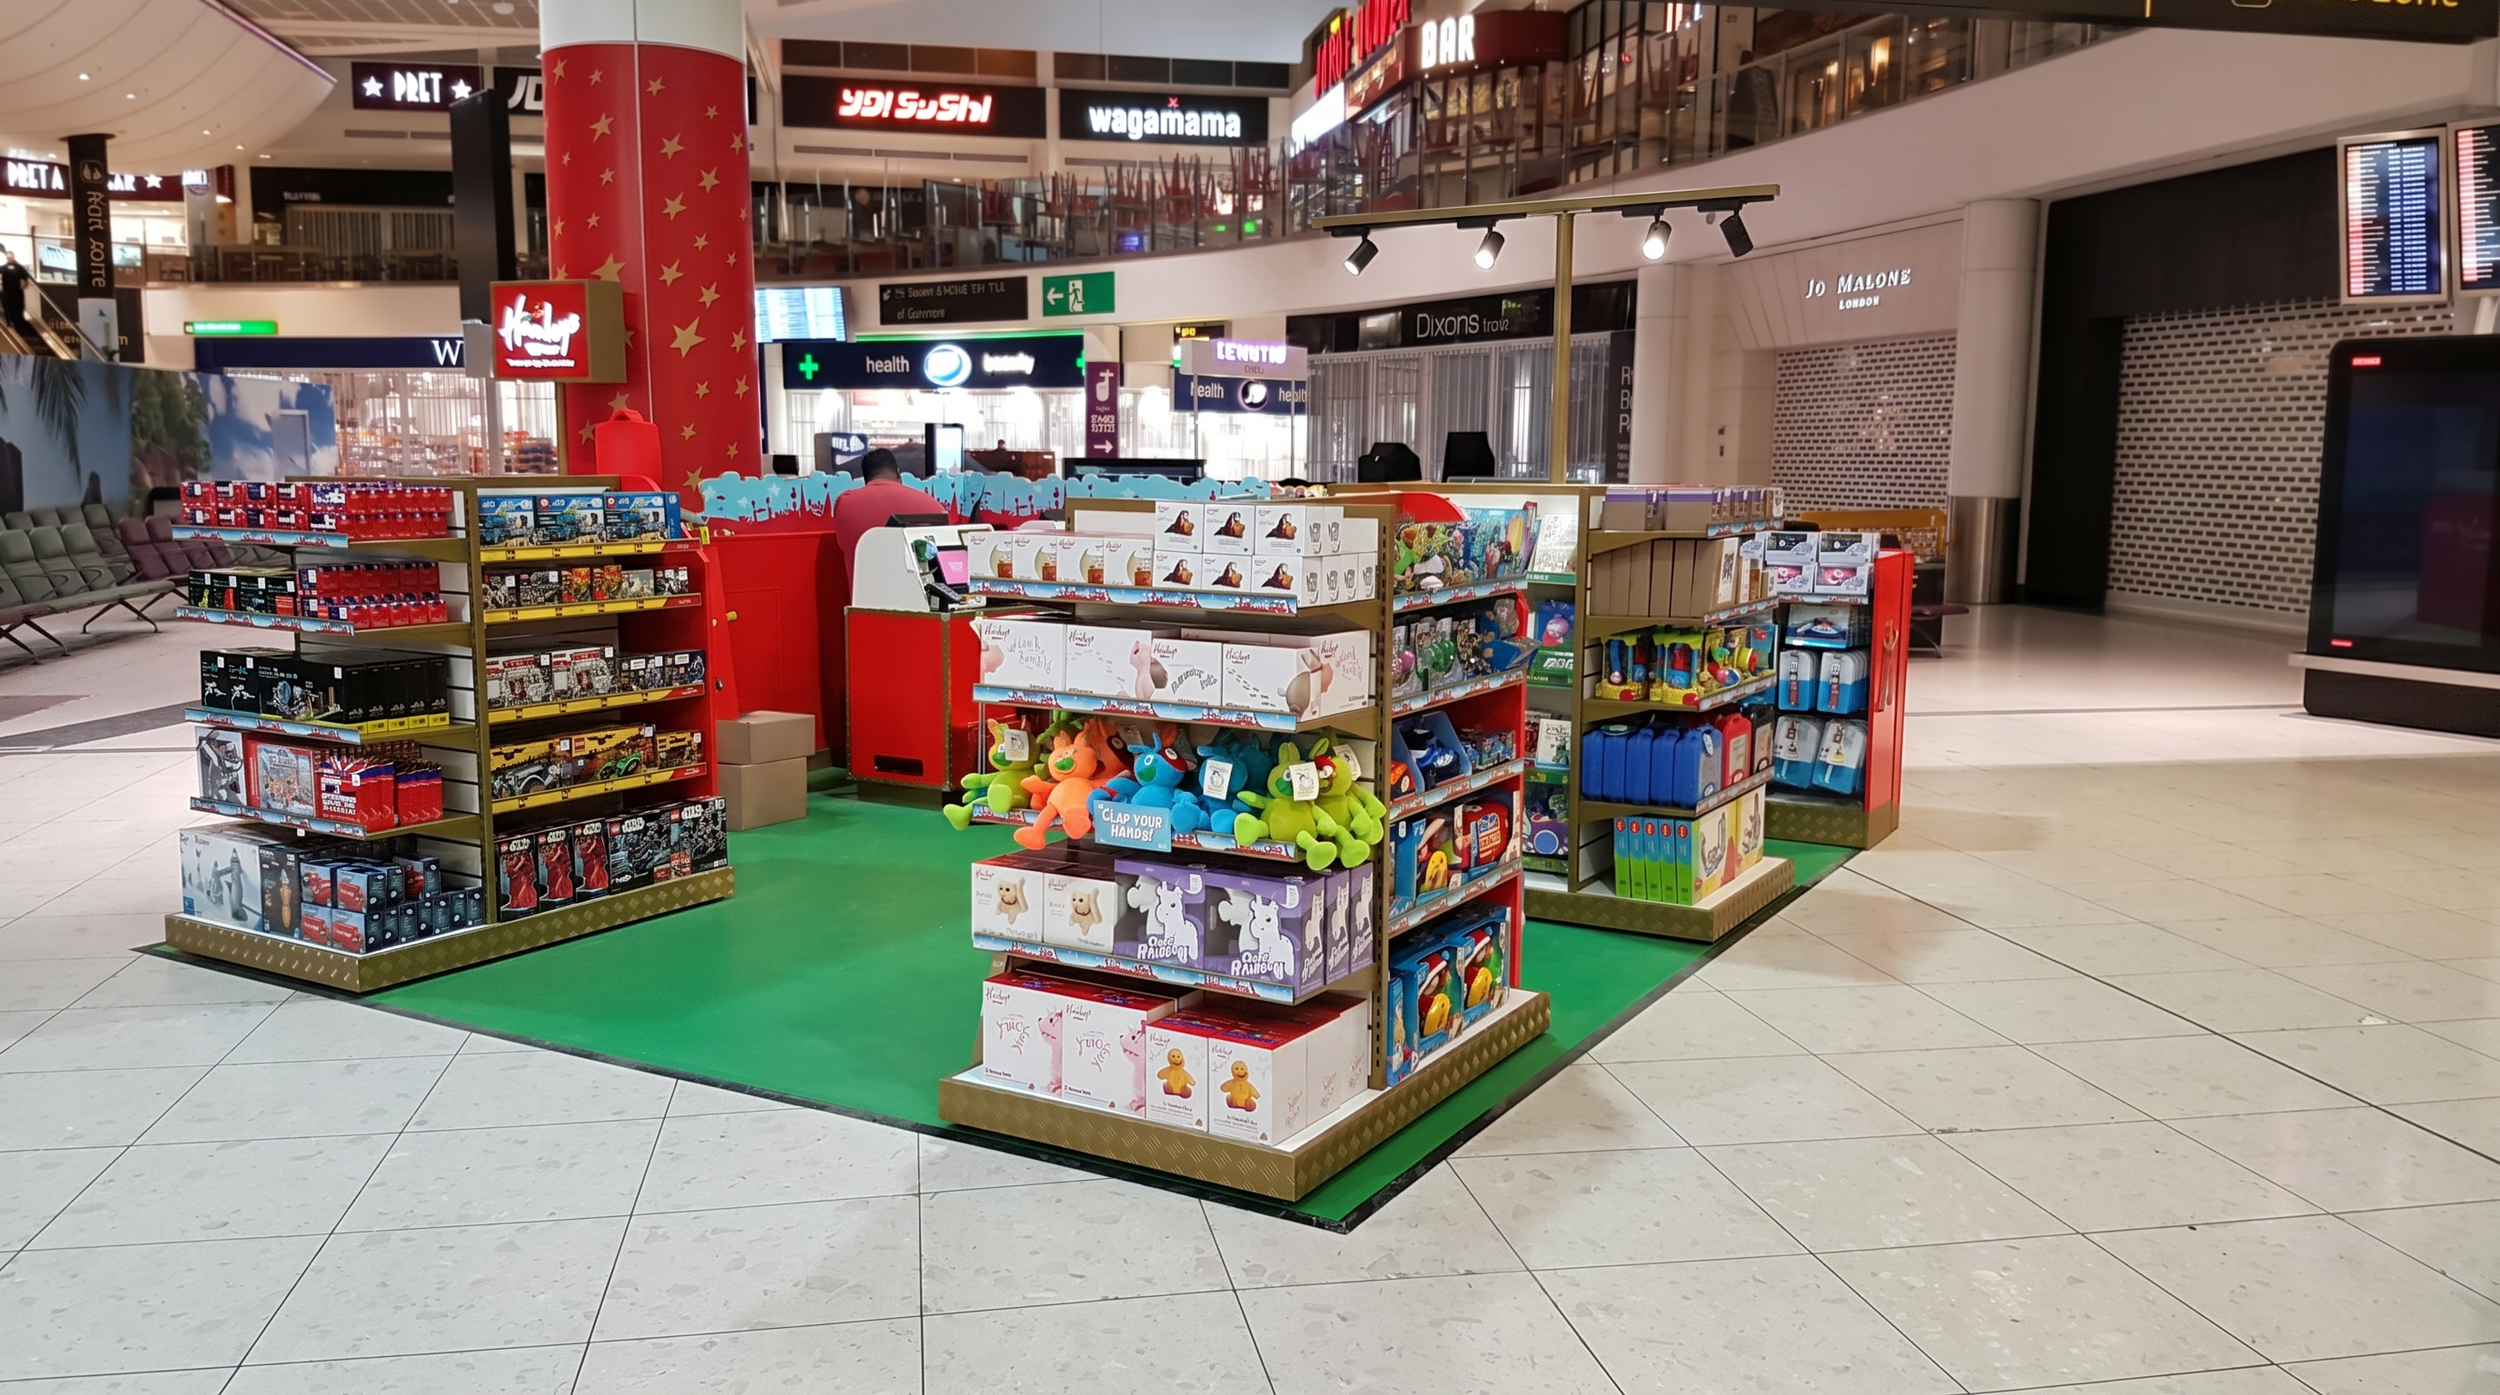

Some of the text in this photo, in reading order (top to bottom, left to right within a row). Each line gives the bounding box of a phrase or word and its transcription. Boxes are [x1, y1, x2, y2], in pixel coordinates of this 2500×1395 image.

[1421, 14, 1475, 69] BAR
[393, 70, 443, 103] PRET
[1088, 104, 1241, 140] wagamama
[7, 160, 48, 190] PRET
[1838, 295, 1880, 311] LONDON
[1416, 312, 1480, 339] Dixons
[865, 355, 910, 374] health
[1102, 808, 1163, 829] CLAP YOUR
